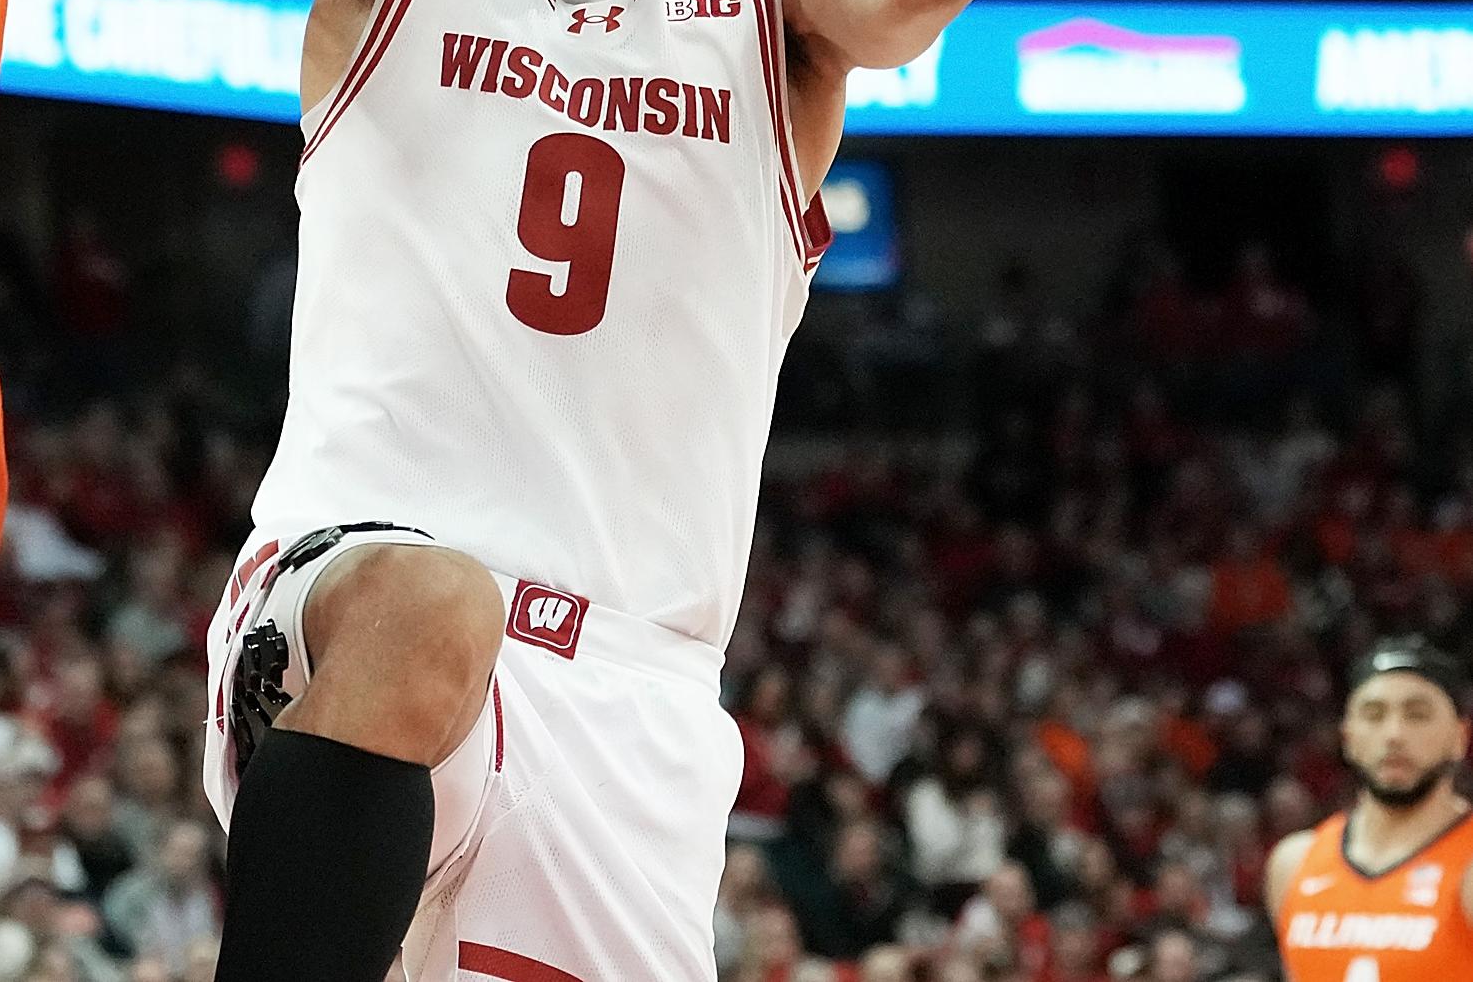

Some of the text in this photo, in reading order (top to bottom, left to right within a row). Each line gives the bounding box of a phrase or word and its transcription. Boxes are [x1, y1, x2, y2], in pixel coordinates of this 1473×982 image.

[440, 32, 732, 145] WISCONSIN
[506, 132, 626, 336] 9
[527, 596, 573, 633] W
